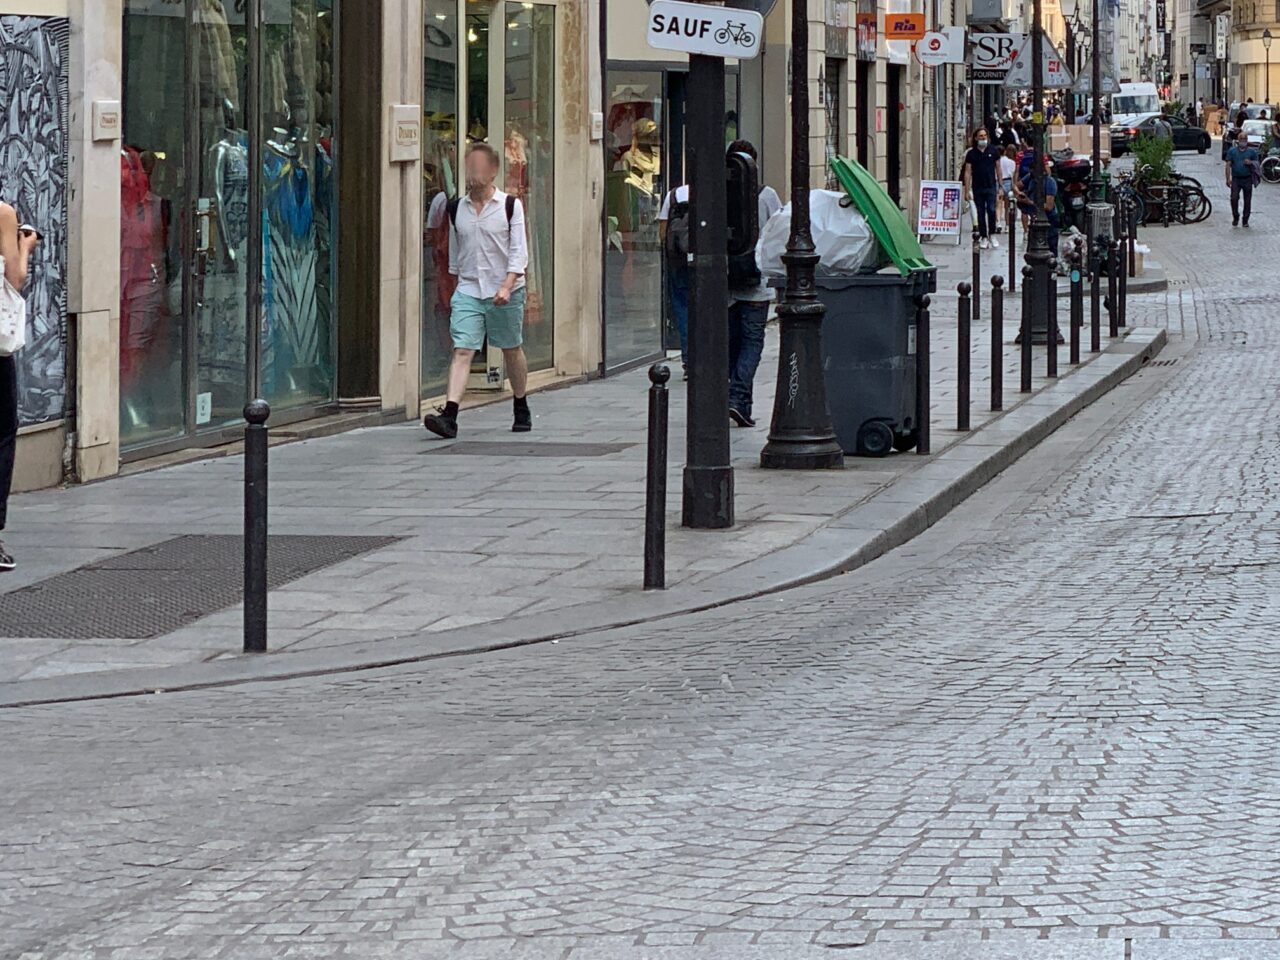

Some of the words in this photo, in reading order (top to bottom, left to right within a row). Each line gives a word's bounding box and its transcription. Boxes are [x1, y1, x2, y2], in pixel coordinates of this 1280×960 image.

[651, 14, 713, 39] SAUF
[893, 18, 917, 32] Ria
[977, 36, 1014, 62] SR
